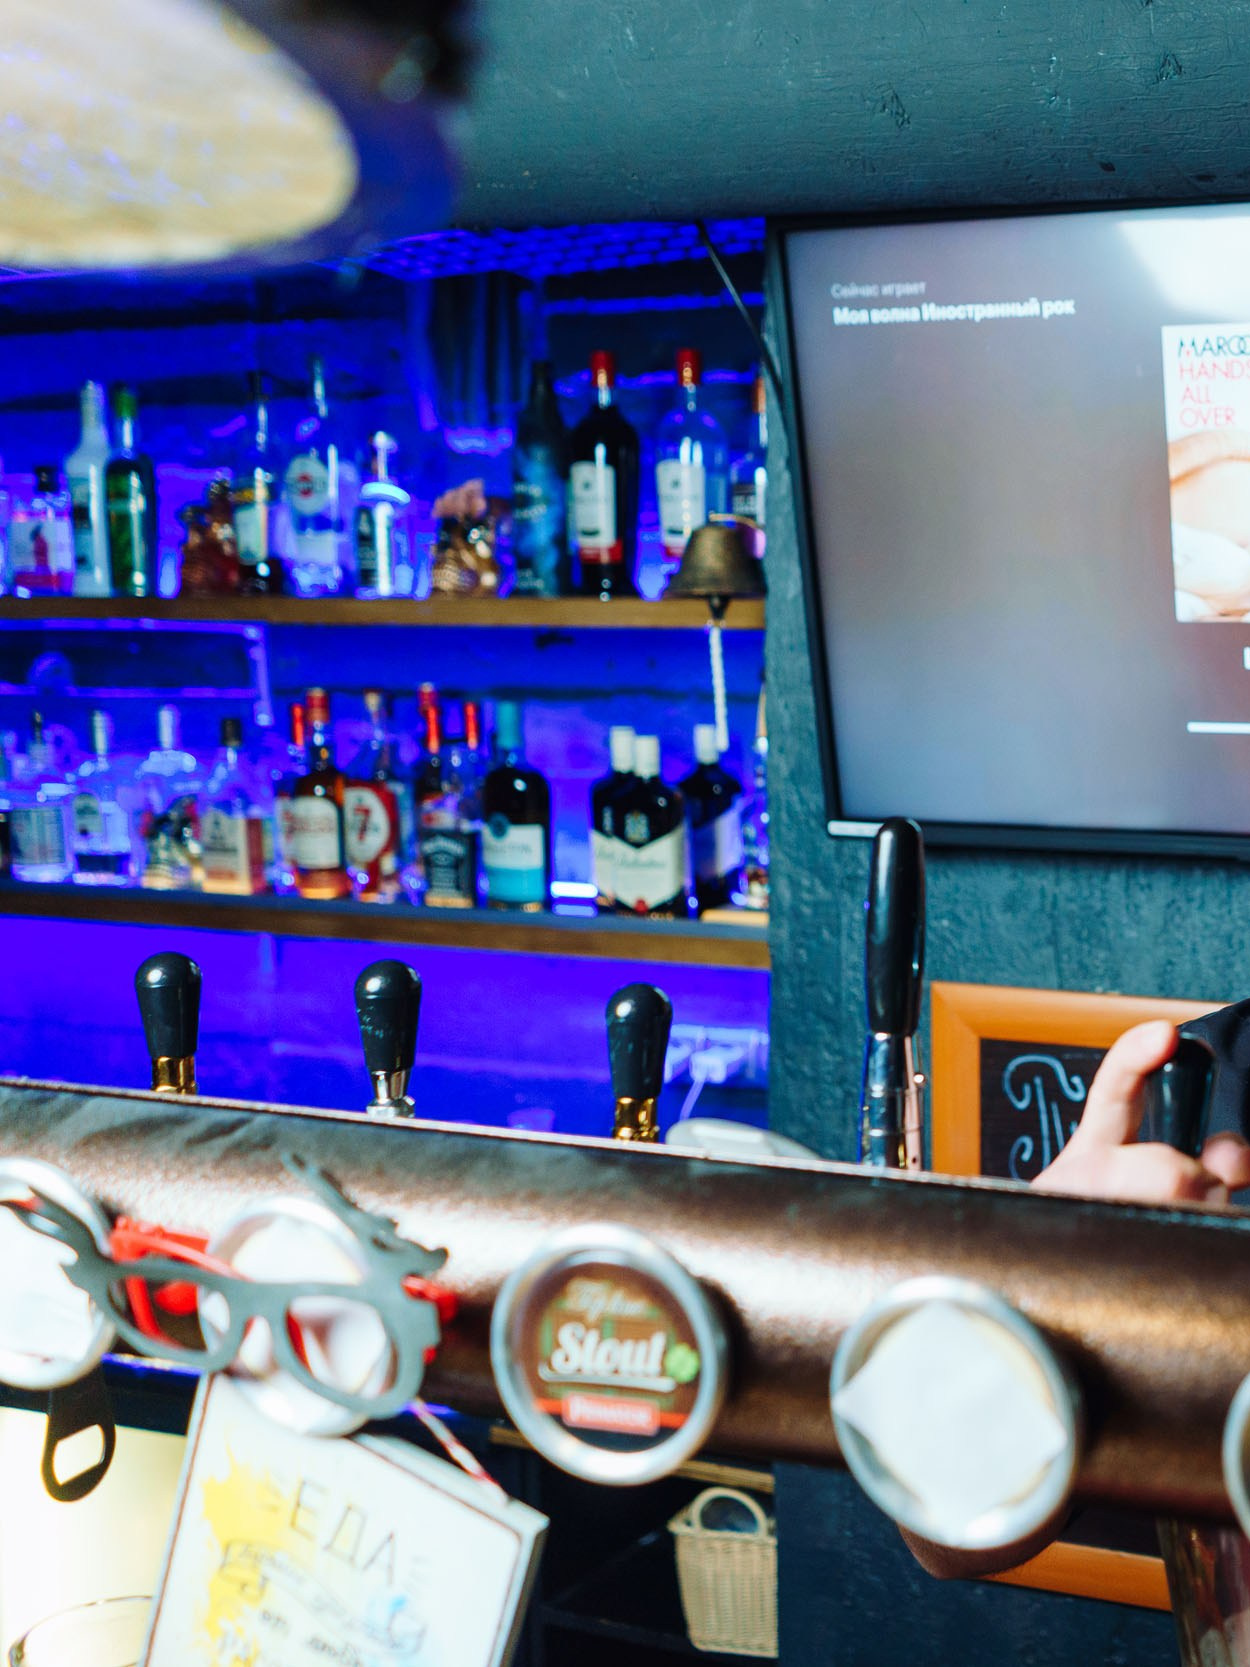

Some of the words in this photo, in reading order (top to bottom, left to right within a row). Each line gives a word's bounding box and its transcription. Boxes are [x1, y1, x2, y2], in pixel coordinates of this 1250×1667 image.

[832, 306, 869, 326] Моя
[870, 307, 920, 324] волна
[921, 297, 1041, 322] Иностранный
[1042, 299, 1076, 320] рок
[1181, 384, 1211, 404] ALL
[1179, 406, 1236, 428] OVER
[551, 1321, 667, 1377] Stout
